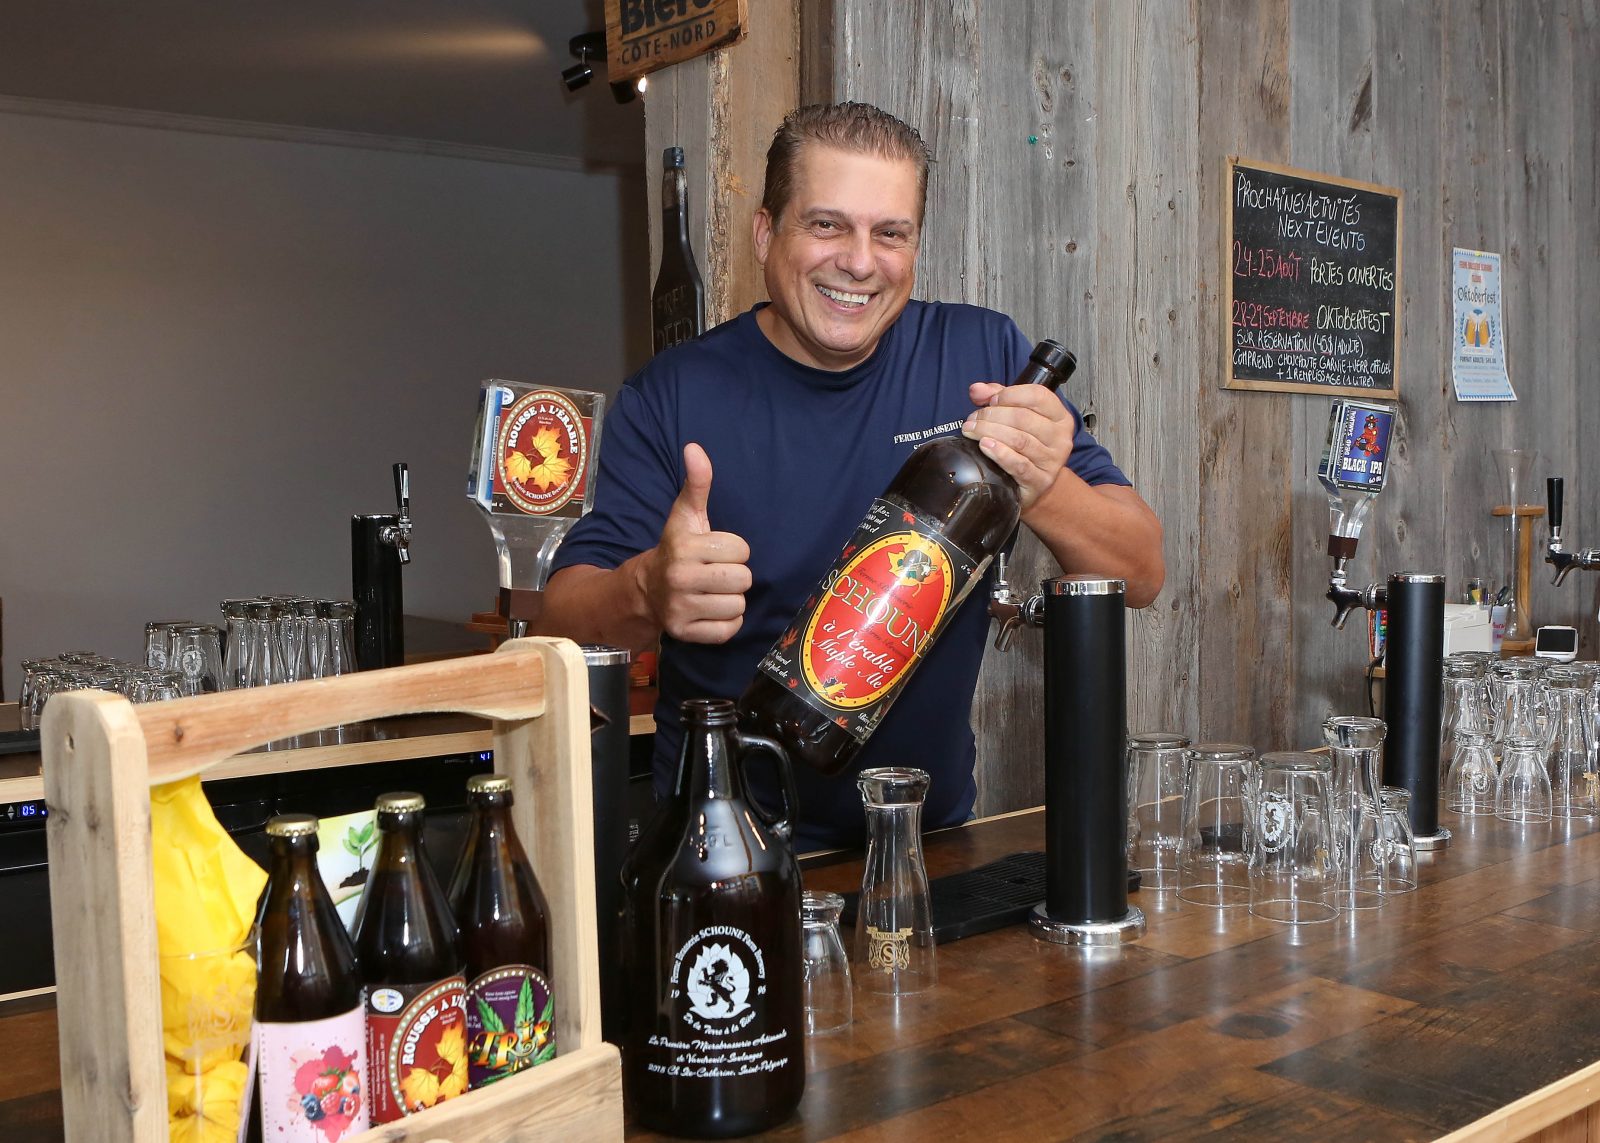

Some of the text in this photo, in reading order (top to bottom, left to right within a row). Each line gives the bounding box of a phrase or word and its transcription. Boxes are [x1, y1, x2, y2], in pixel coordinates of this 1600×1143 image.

[1278, 214, 1366, 251] NEXT EVENTS
[1234, 240, 1274, 278] 24-25
[1310, 257, 1343, 286] PORTES
[1458, 286, 1496, 304] Oktoberfest
[1232, 300, 1262, 329] 28-29
[1236, 329, 1255, 347] SUR
[1233, 349, 1274, 369] COMPREND
[508, 406, 537, 448] ROUSSE
[549, 404, 578, 454] L'ÉRABLE
[894, 432, 922, 444] FERME
[1342, 457, 1382, 474] BLACK IPA
[526, 490, 552, 499] SCHOUNE
[822, 618, 896, 674] à l'érable
[811, 638, 882, 688] Maple Ale
[699, 926, 744, 939] SCHOUNE
[670, 989, 680, 998] 19
[402, 1005, 439, 1065] ROUSSE
